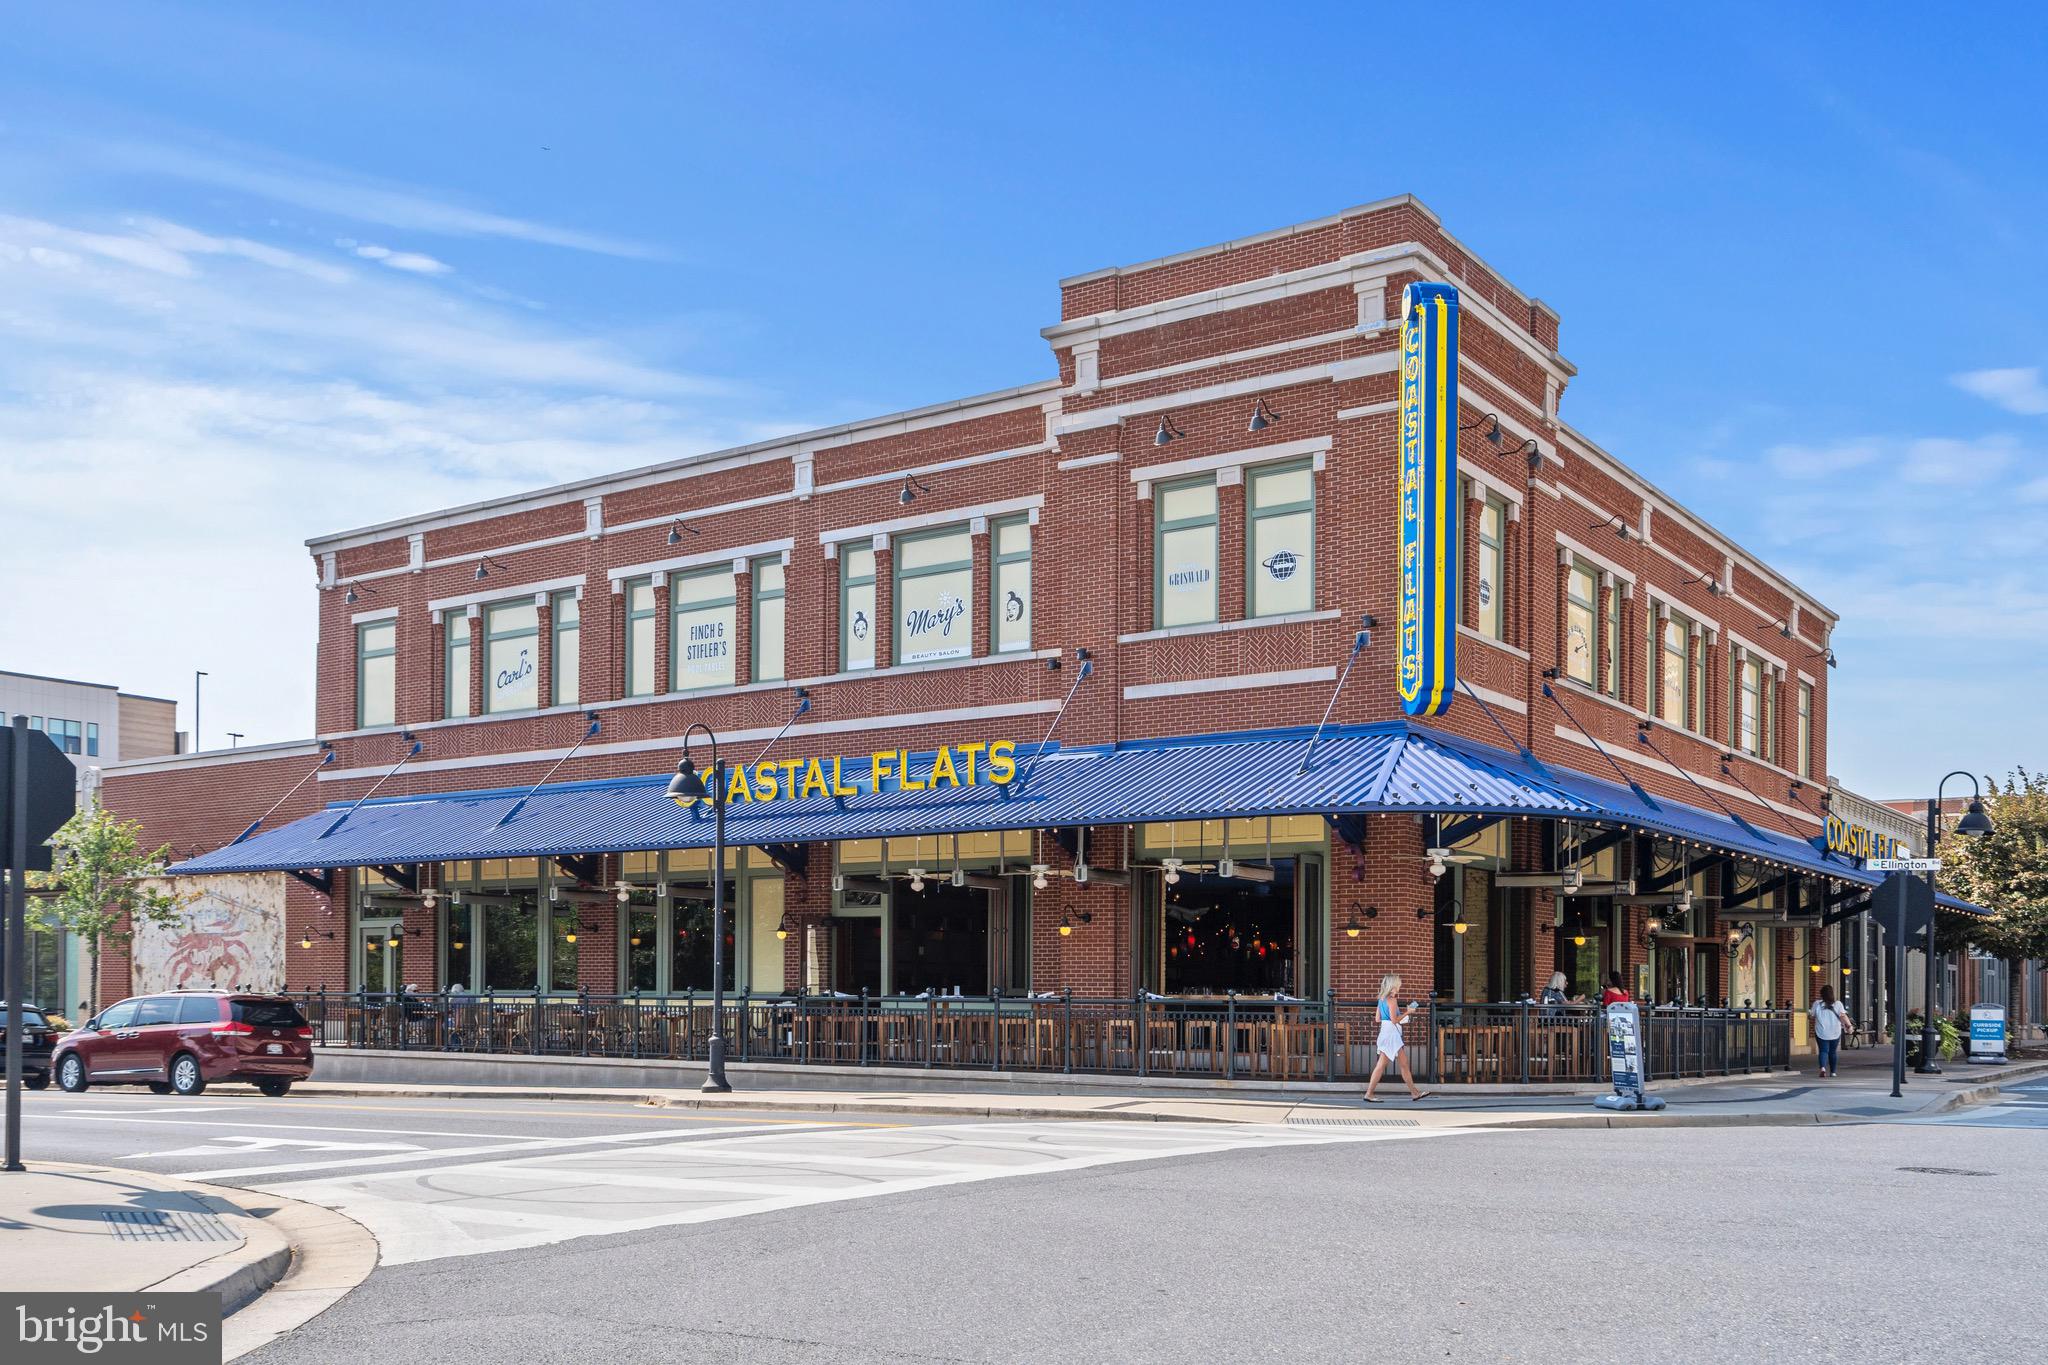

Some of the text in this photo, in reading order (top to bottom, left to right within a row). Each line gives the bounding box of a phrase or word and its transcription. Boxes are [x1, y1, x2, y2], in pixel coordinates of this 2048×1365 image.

[1404, 327, 1419, 679] COASTAL FLATS
[1169, 569, 1210, 586] GRISWALD
[906, 598, 966, 638] Mary's
[690, 622, 724, 641] FINCH &
[687, 641, 727, 661] STIFLER'S
[911, 649, 960, 660] BEAUTY SALON
[497, 658, 533, 689] Carl's
[674, 739, 1017, 808] ASTAL FLATS
[1826, 815, 1876, 859] COASTAL
[1880, 860, 1927, 870] Ellington
